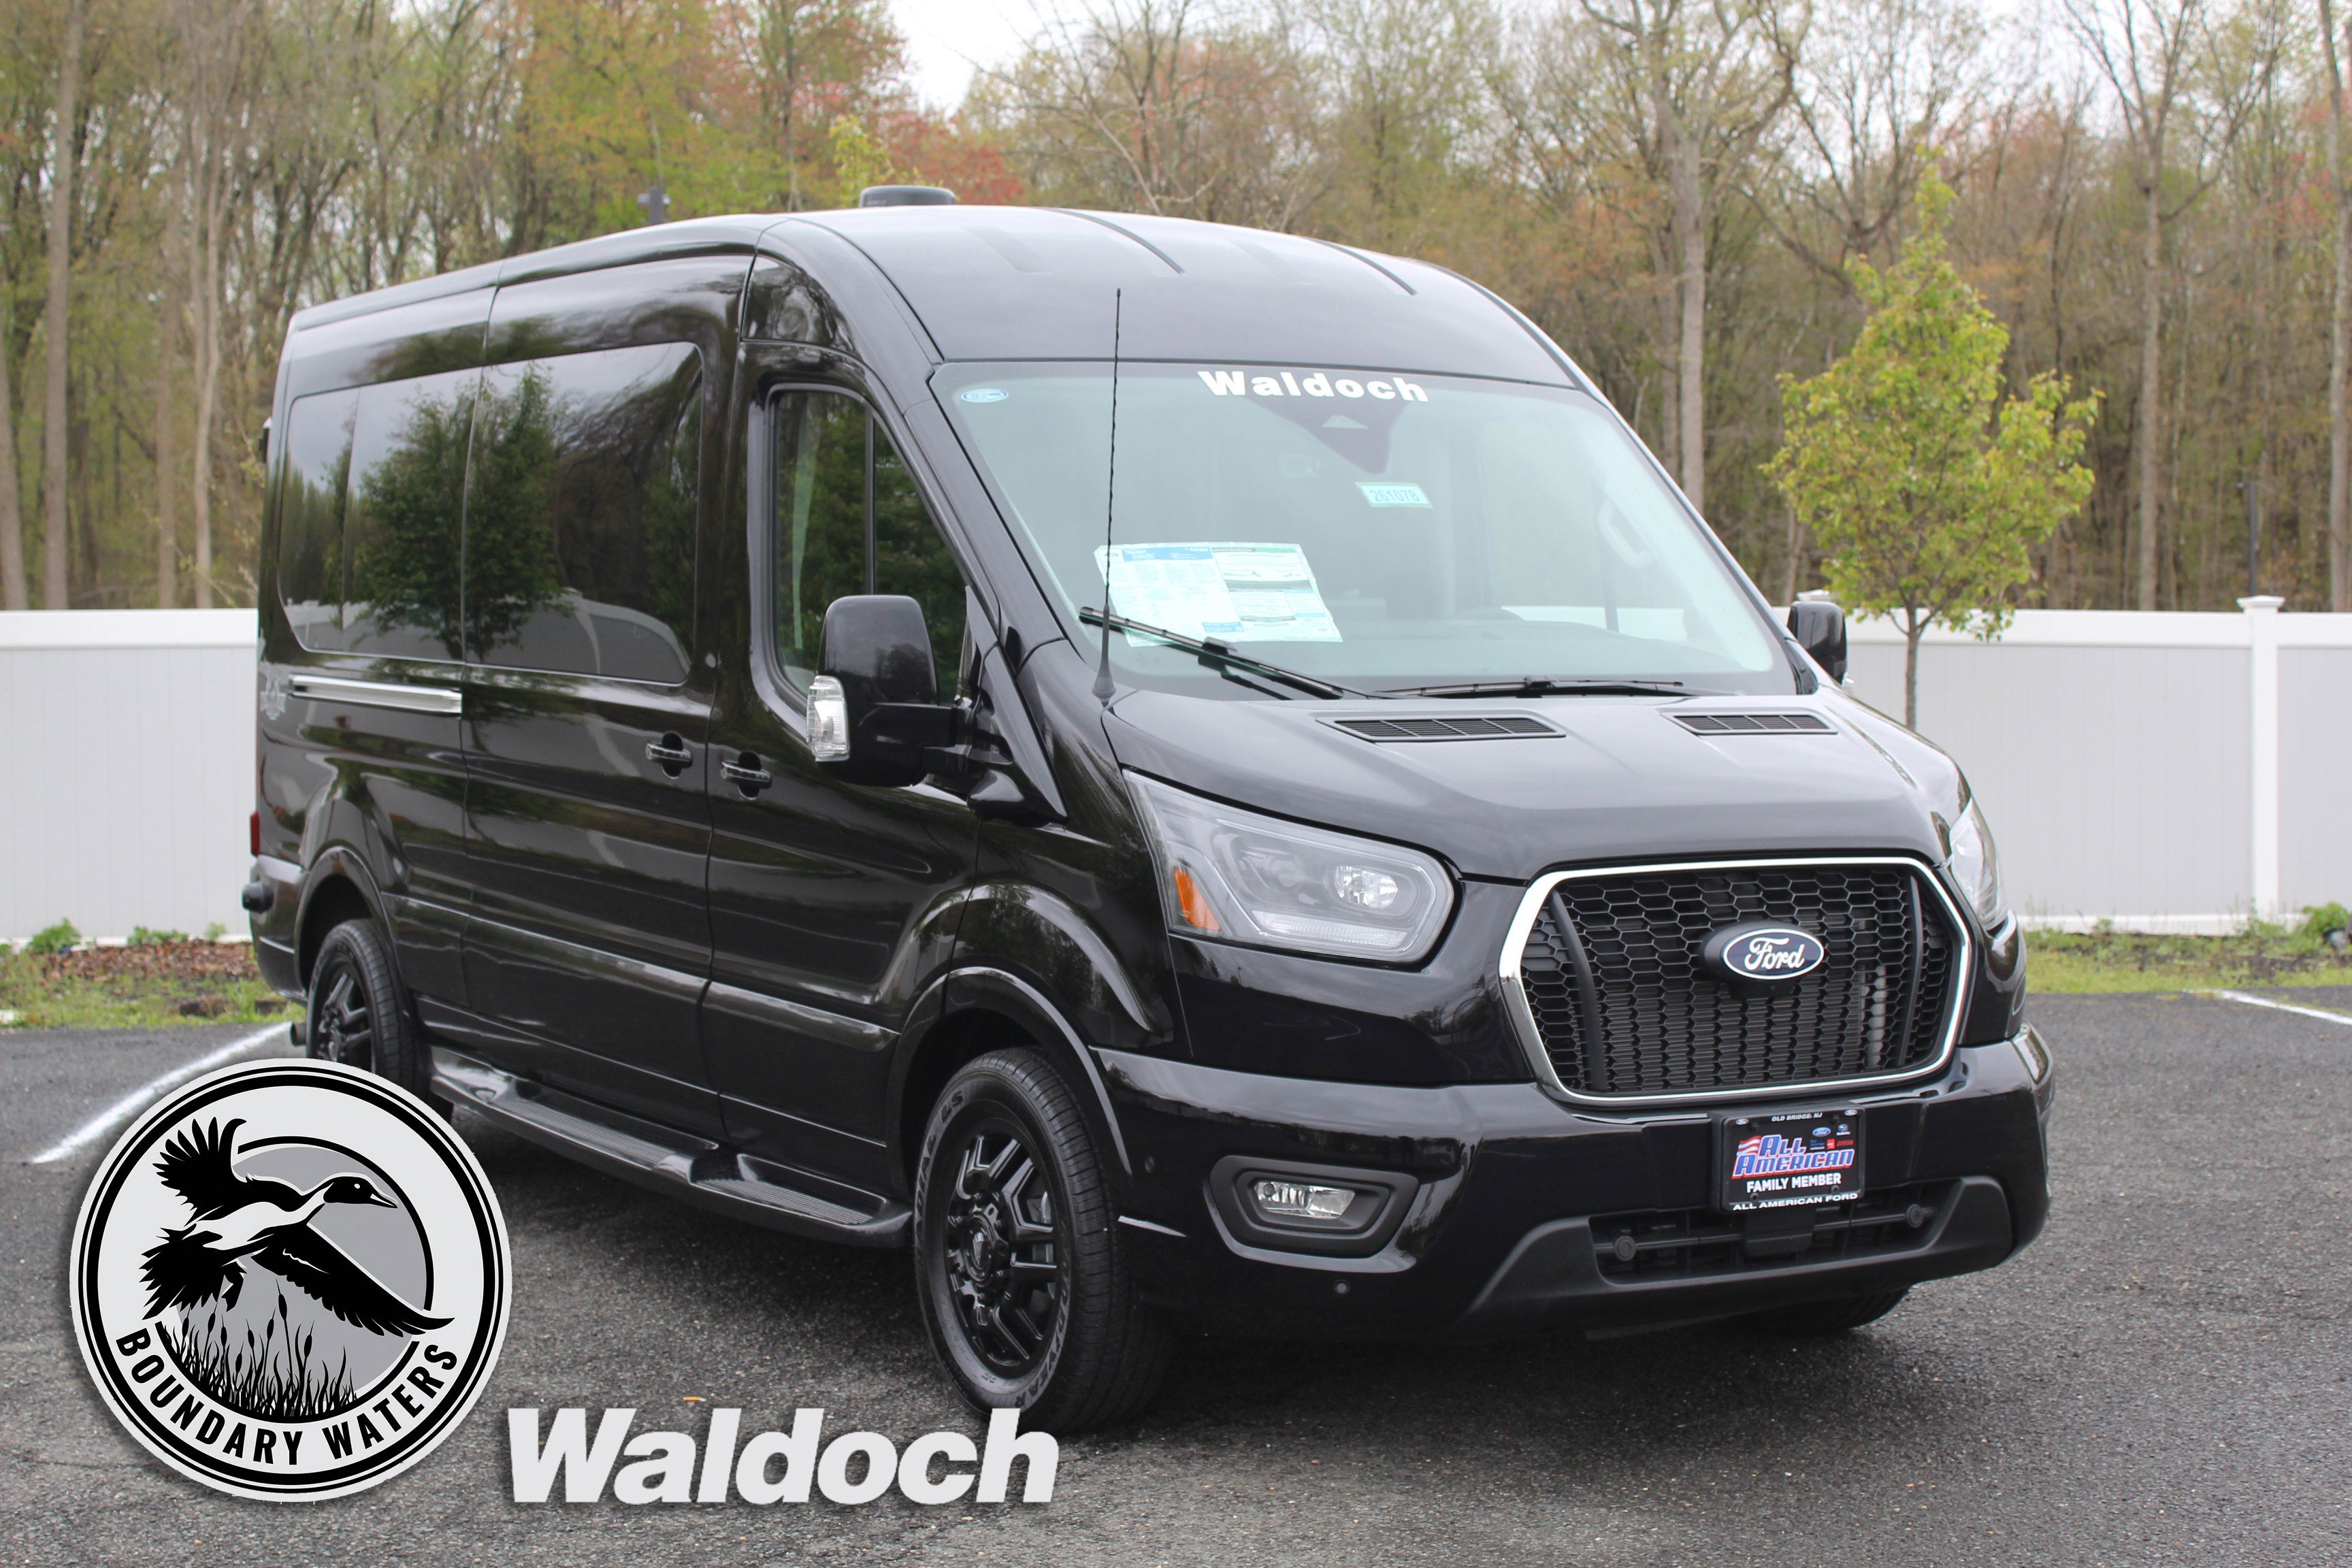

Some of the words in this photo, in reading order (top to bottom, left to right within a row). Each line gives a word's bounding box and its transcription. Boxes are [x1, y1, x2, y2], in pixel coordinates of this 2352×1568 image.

[1197, 371, 1428, 402] Waldoch
[1369, 489, 1420, 502] 261078
[1744, 936, 1806, 970] Ford
[1759, 1134, 1807, 1157] ALL
[1732, 1149, 1855, 1179] AMERICAN
[1746, 1177, 1790, 1193] FAMILY
[1791, 1173, 1842, 1189] MEMBER
[1733, 1203, 1757, 1211] ALL
[1759, 1196, 1824, 1209] AMERICAN
[1825, 1193, 1859, 1203] FORD
